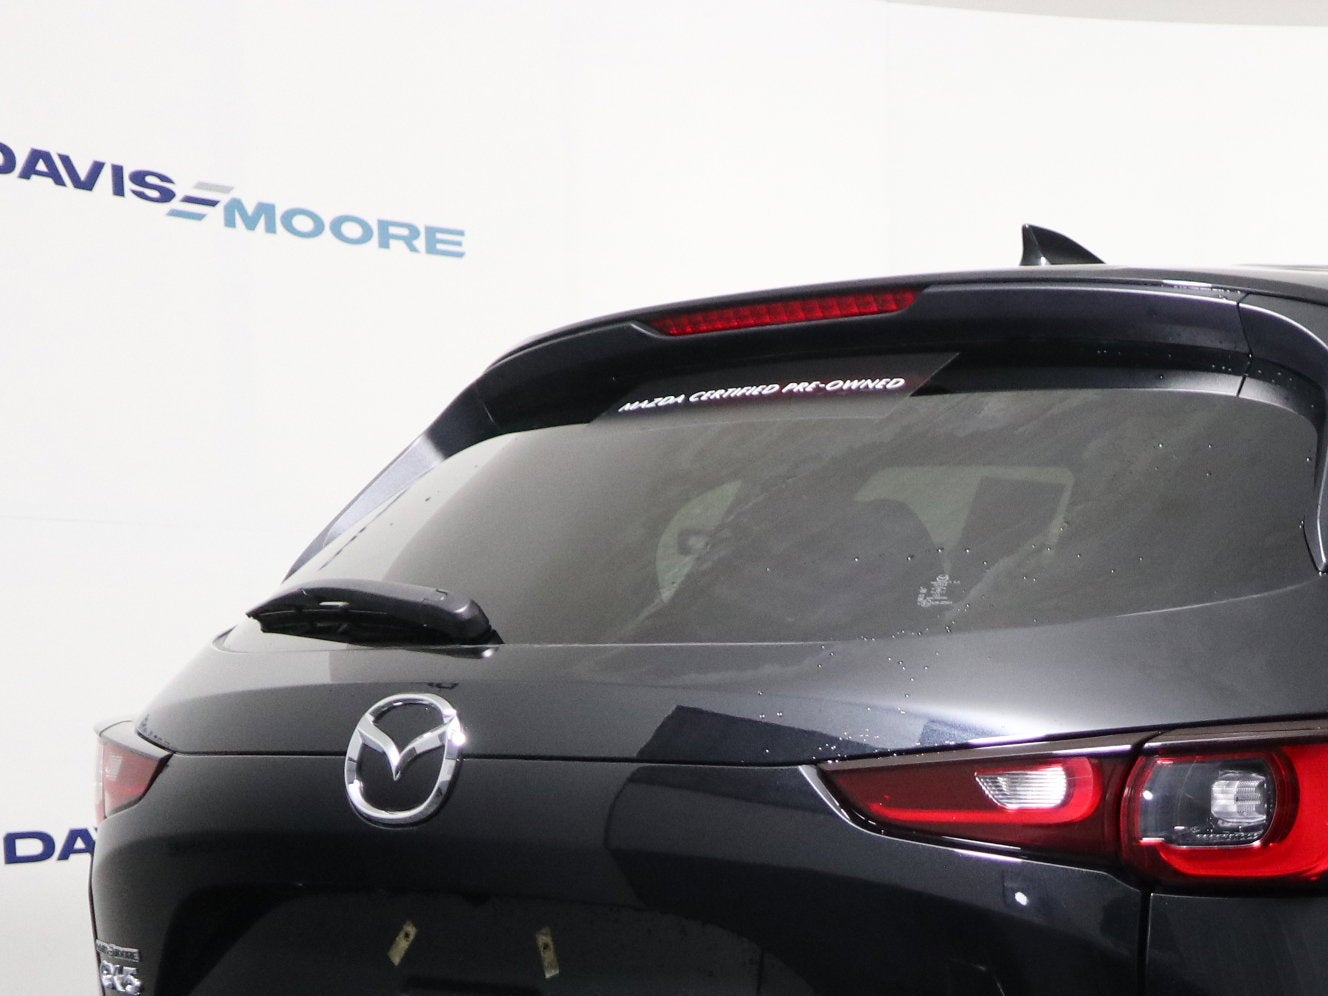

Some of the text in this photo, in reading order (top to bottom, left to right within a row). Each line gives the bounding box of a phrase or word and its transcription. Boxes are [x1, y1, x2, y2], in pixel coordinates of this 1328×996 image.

[224, 197, 466, 259] MOORE
[617, 377, 905, 412] MAZDA CERTIFIED PRE-OWNED
